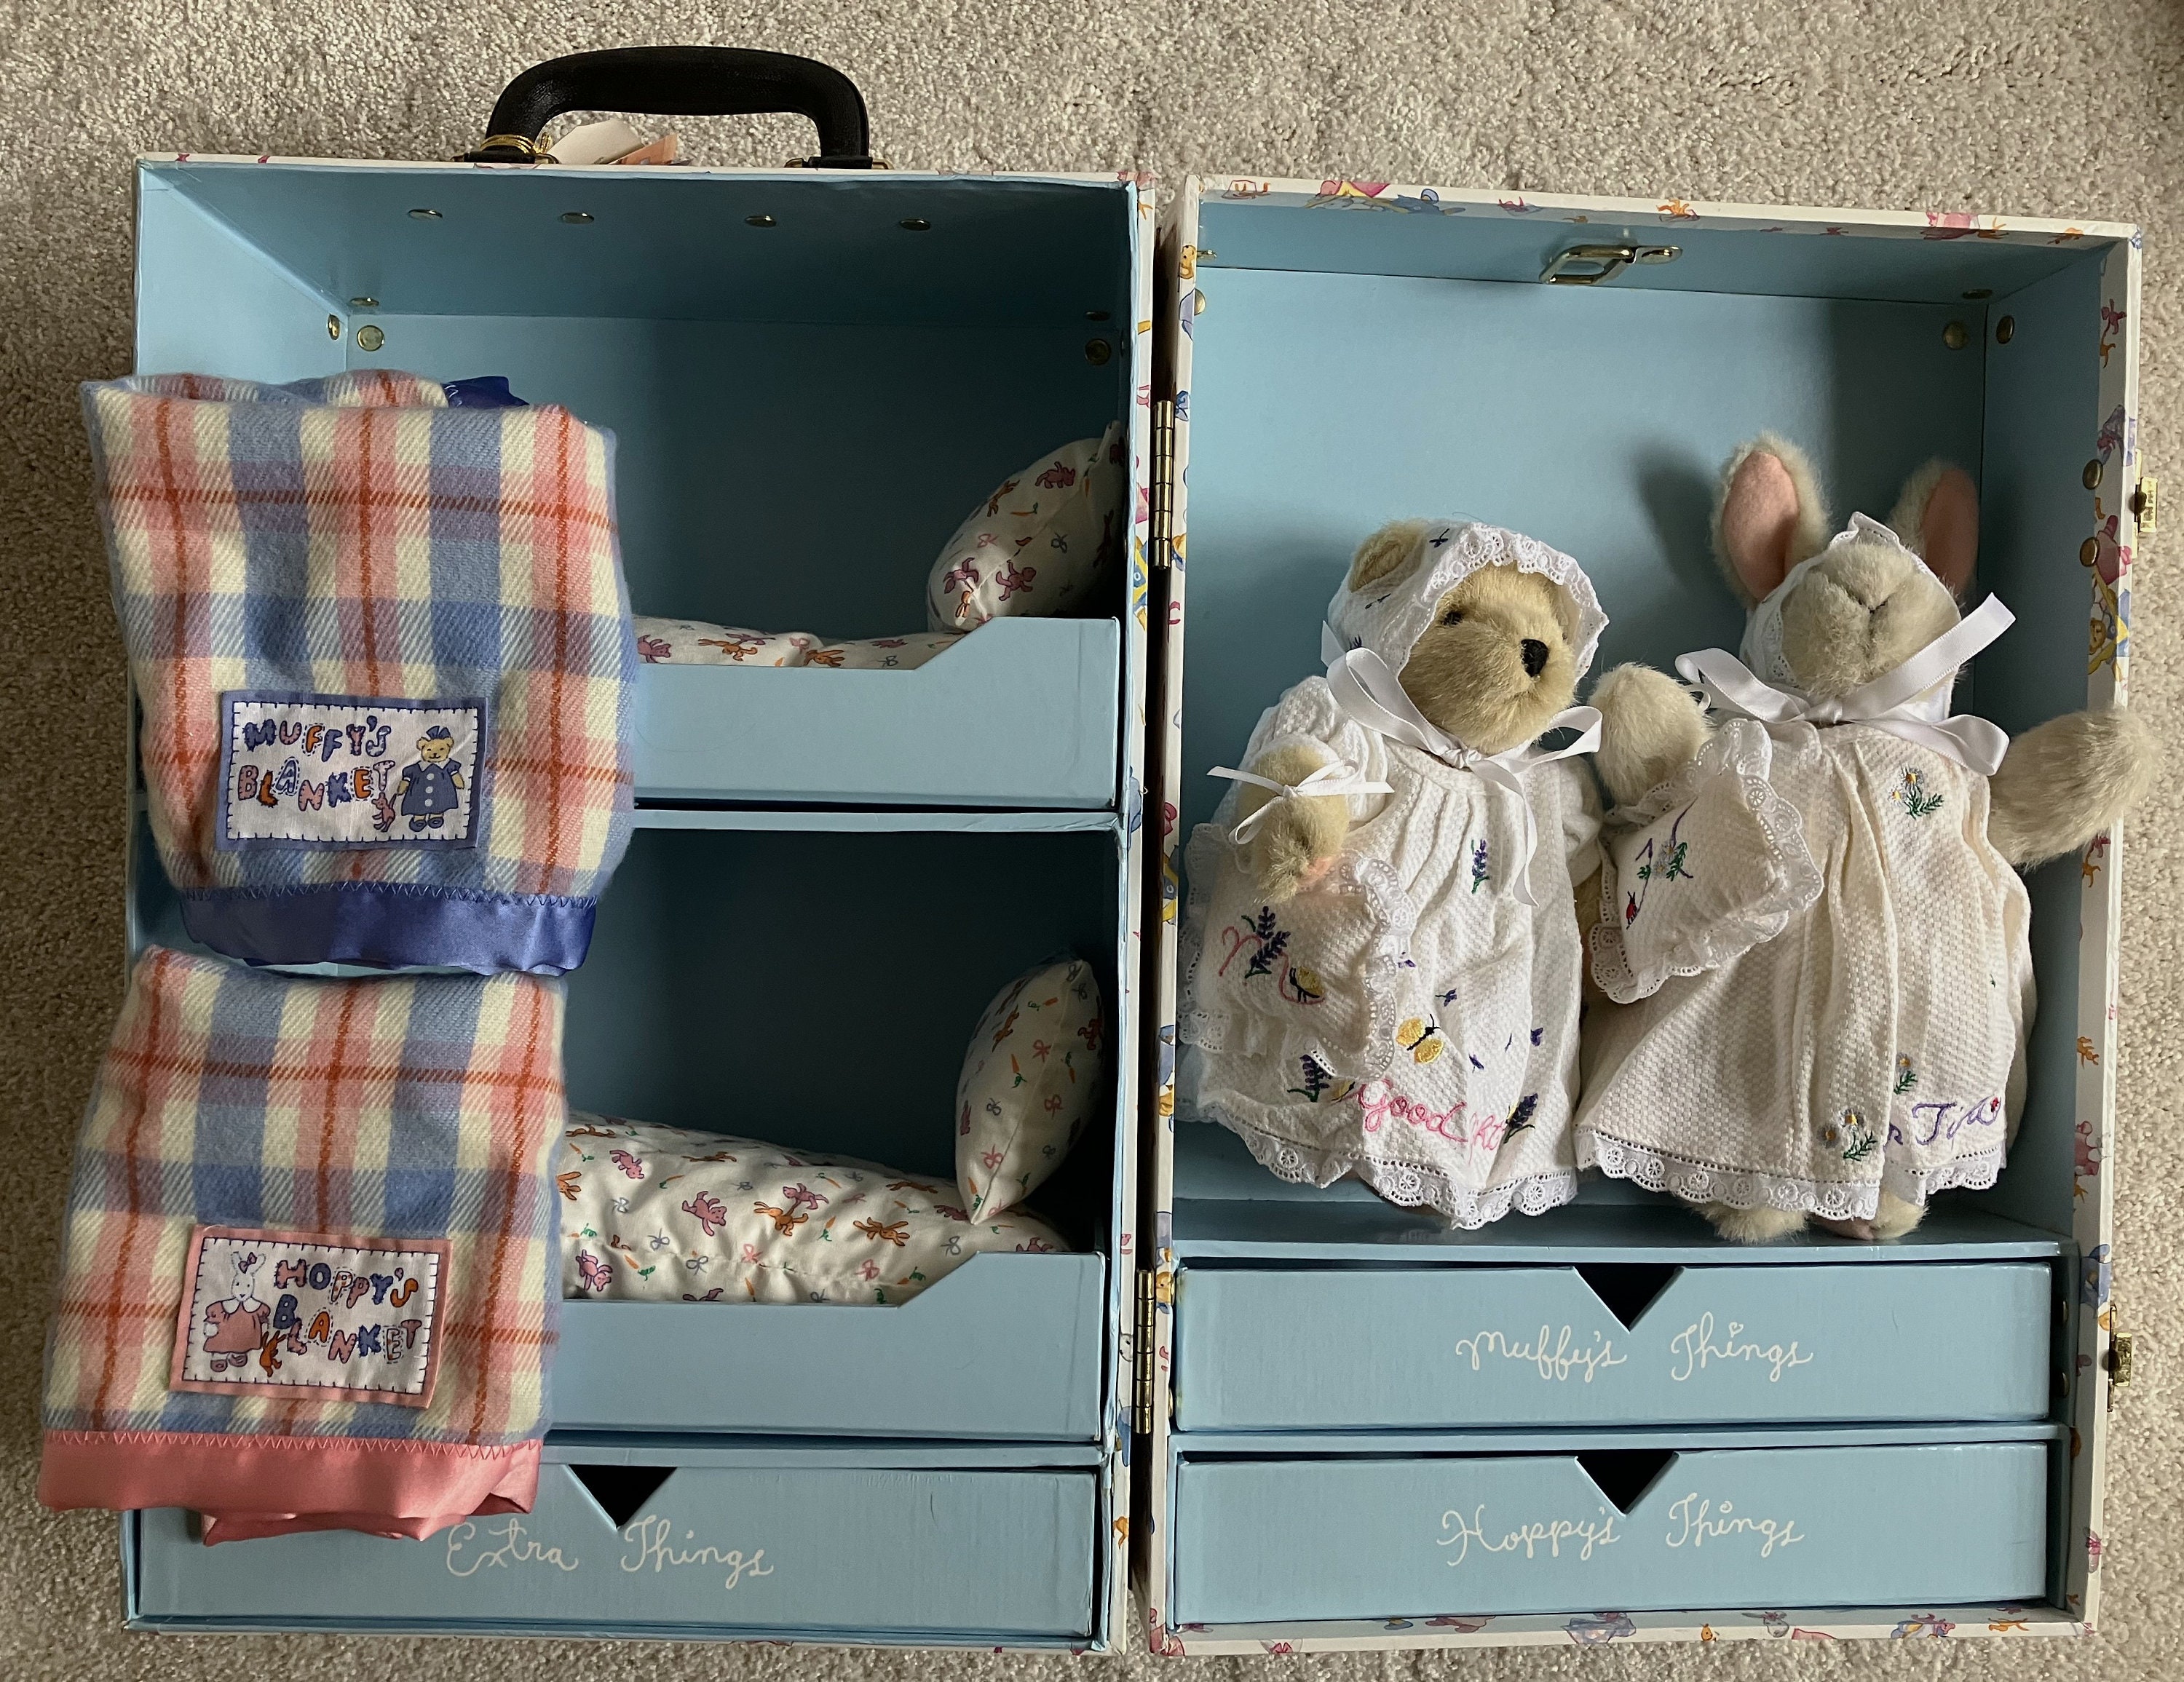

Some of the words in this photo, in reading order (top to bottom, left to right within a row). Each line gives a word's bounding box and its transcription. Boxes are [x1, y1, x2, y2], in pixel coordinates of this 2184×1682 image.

[242, 715, 392, 762] MUFFY'S
[237, 756, 396, 811] BLANKET
[274, 1258, 419, 1309] HOPPY'S
[272, 1293, 422, 1365] BLANKET
[1455, 1324, 1628, 1383] Muffy's
[1670, 1312, 1813, 1382] Things
[446, 1518, 579, 1577] Extra
[620, 1515, 775, 1590] Things
[1436, 1504, 1621, 1566] Hoppy's
[1666, 1492, 1805, 1558] Things
